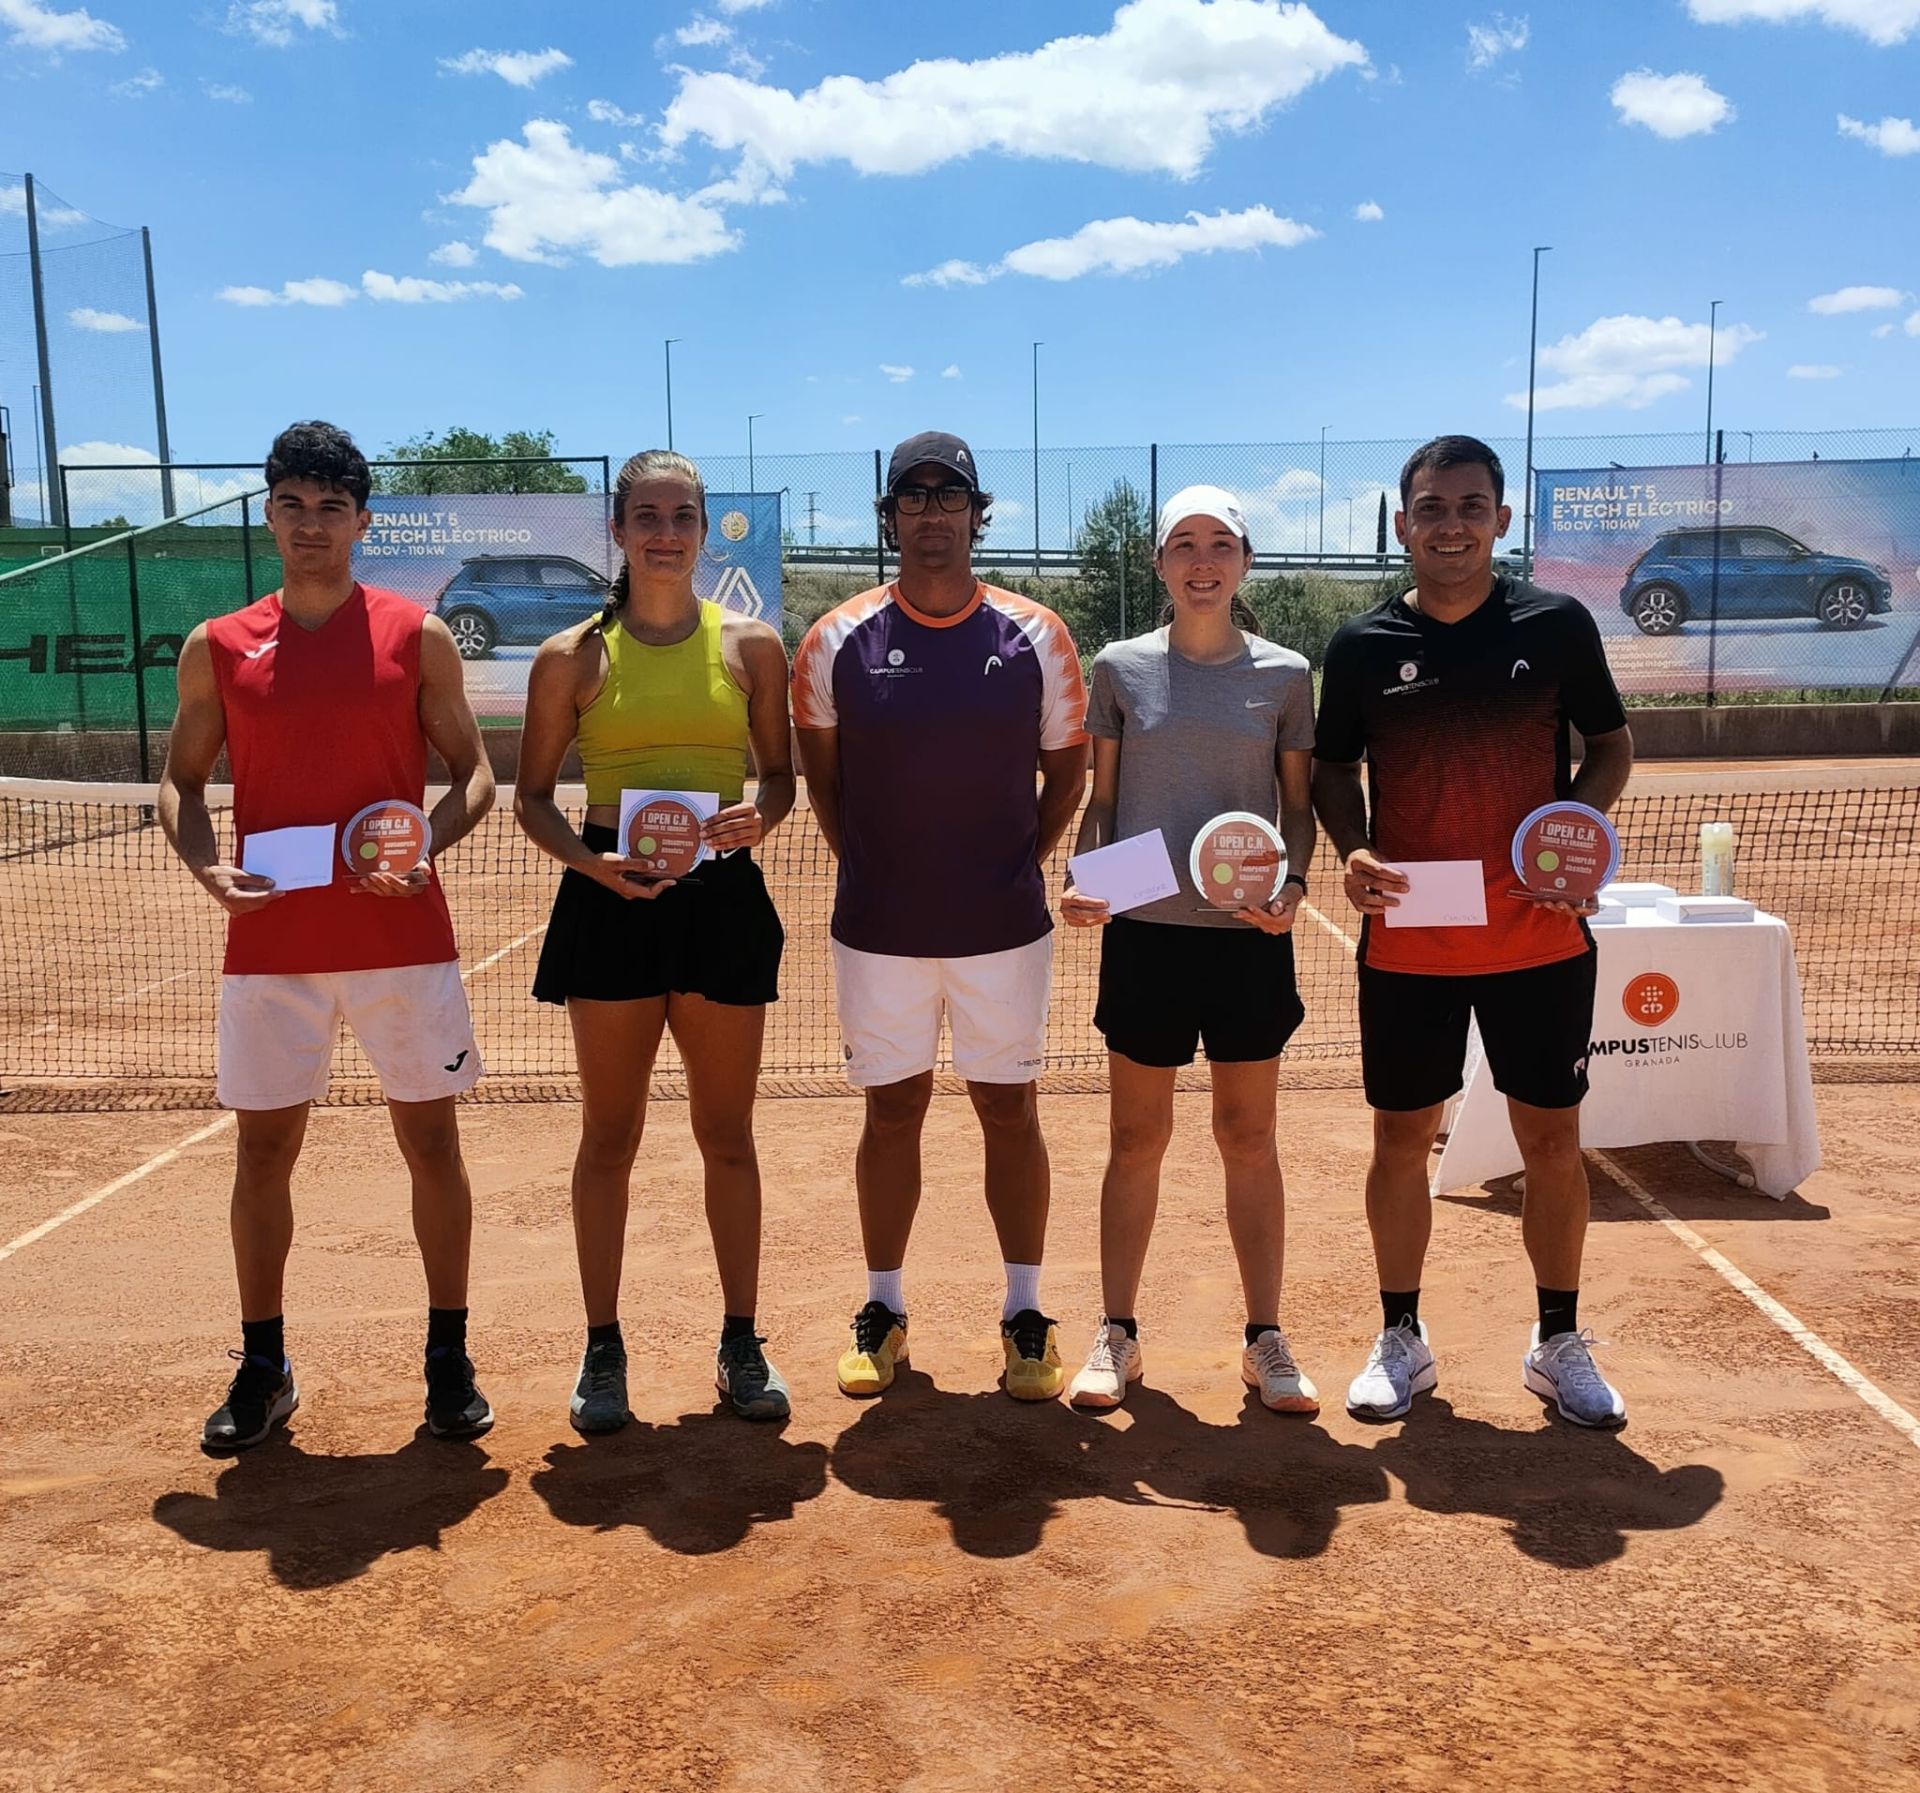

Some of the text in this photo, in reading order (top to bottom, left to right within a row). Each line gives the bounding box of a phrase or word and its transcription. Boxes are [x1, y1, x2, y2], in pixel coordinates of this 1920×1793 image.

[1553, 484, 1656, 502] RENAULT 5
[1552, 503, 1622, 519] E-TECH
[371, 512, 459, 527] ENAULT 5
[1552, 521, 1572, 531] 150
[1574, 521, 1592, 531] CV
[1600, 520, 1617, 530] 110
[1620, 519, 1641, 529] kW
[362, 527, 531, 544] E-TECH ELÉCTRICO
[362, 546, 381, 556] 150
[382, 546, 400, 556] CV
[408, 546, 425, 556] 110
[426, 546, 445, 556] kW
[0, 634, 185, 674] HEA
[368, 819, 392, 830] OPEN
[647, 812, 670, 825] OPEN
[1546, 823, 1575, 839] OPEN
[1577, 827, 1598, 842] C.N.
[1219, 835, 1245, 849] OPEN
[1588, 1032, 1748, 1056] MPUSTENISCLUB
[1624, 1055, 1681, 1068] GRANADA
